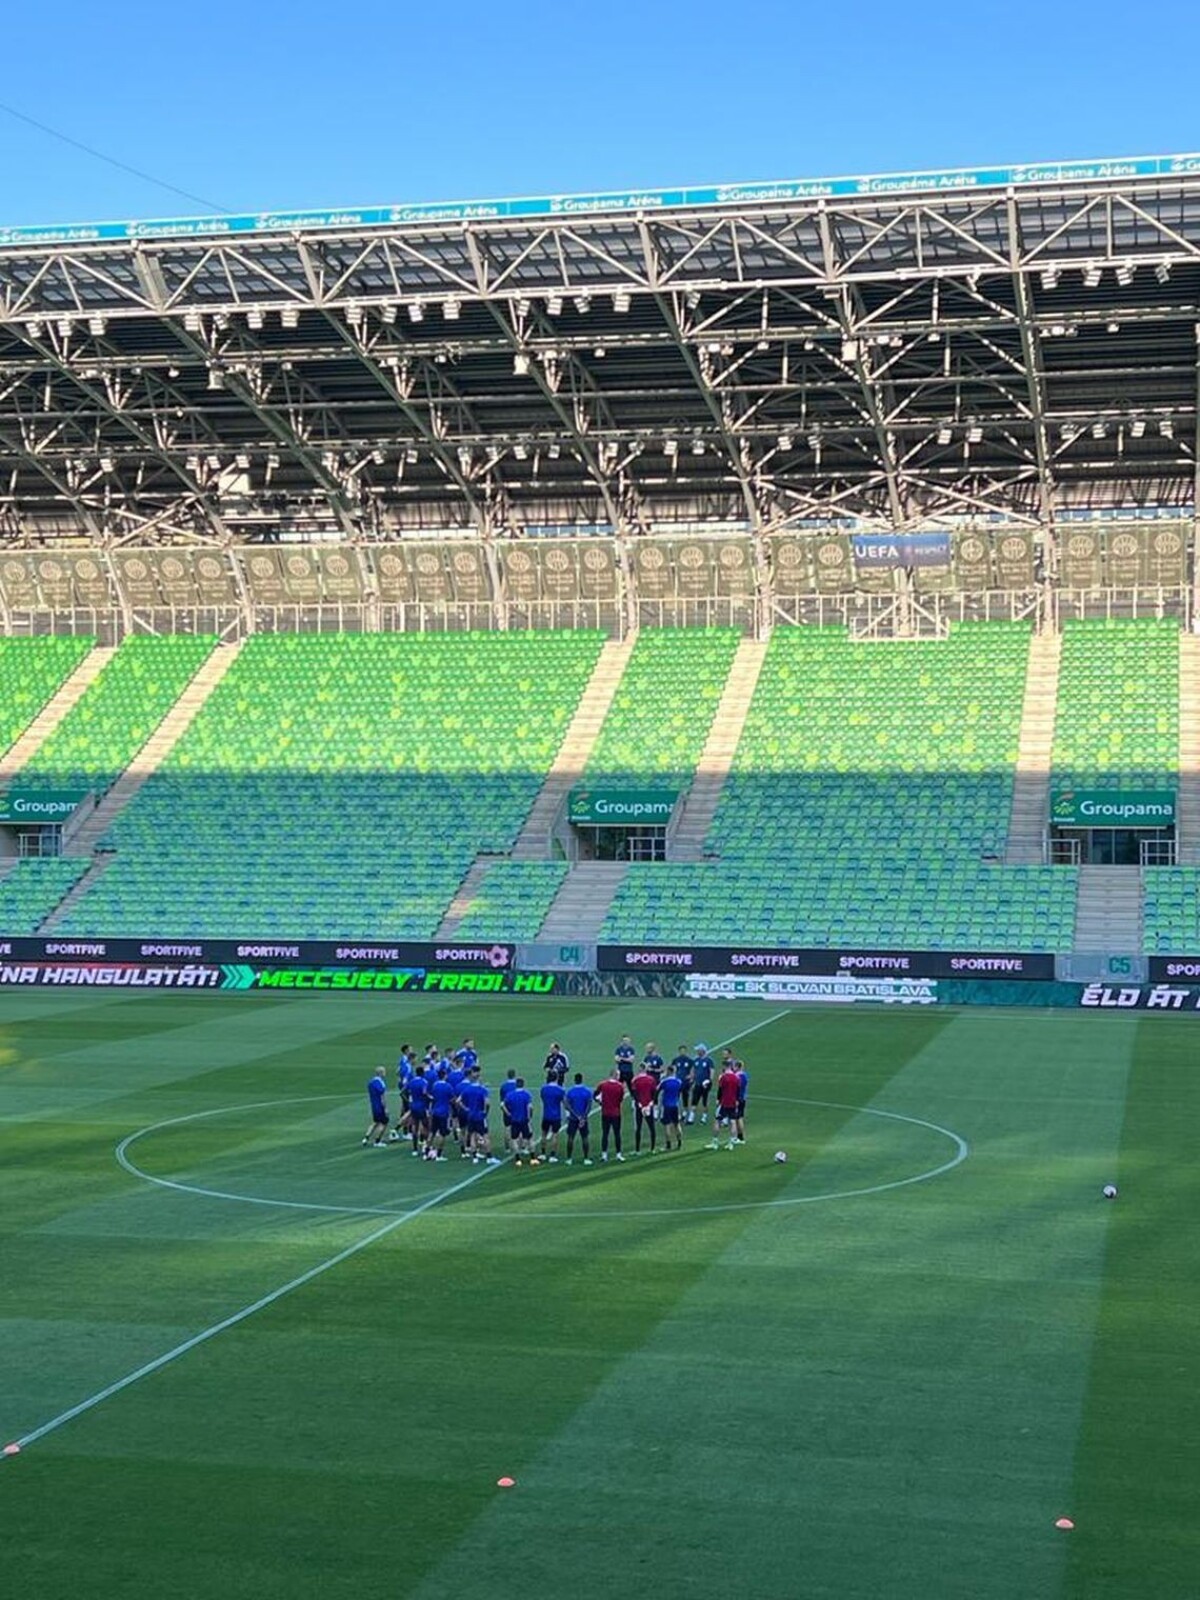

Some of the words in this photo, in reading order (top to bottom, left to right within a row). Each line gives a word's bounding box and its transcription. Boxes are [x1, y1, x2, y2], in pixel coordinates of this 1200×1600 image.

[855, 545, 899, 558] UEFA
[1080, 801, 1173, 818] Groupama
[45, 944, 106, 956] SPORTFIVE
[141, 945, 202, 956] SPORTFIVE
[238, 946, 299, 958] SPORTFIVE
[336, 948, 399, 960] SPORTFIVE
[560, 947, 579, 962] C4
[626, 953, 692, 965] SPORTFIVE
[731, 955, 799, 967] SPORTFIVE
[840, 957, 910, 969] SPORTFIVE
[951, 959, 1023, 971] SPORTFIVE
[1109, 958, 1130, 973] C5
[0, 962, 38, 984] NA
[42, 965, 219, 986] HANGULATÁT!
[768, 982, 831, 994] SLOVAN
[834, 984, 932, 996] BRATISLAVA
[1081, 983, 1141, 1006] ÉLD
[1147, 984, 1190, 1007] ÁT
